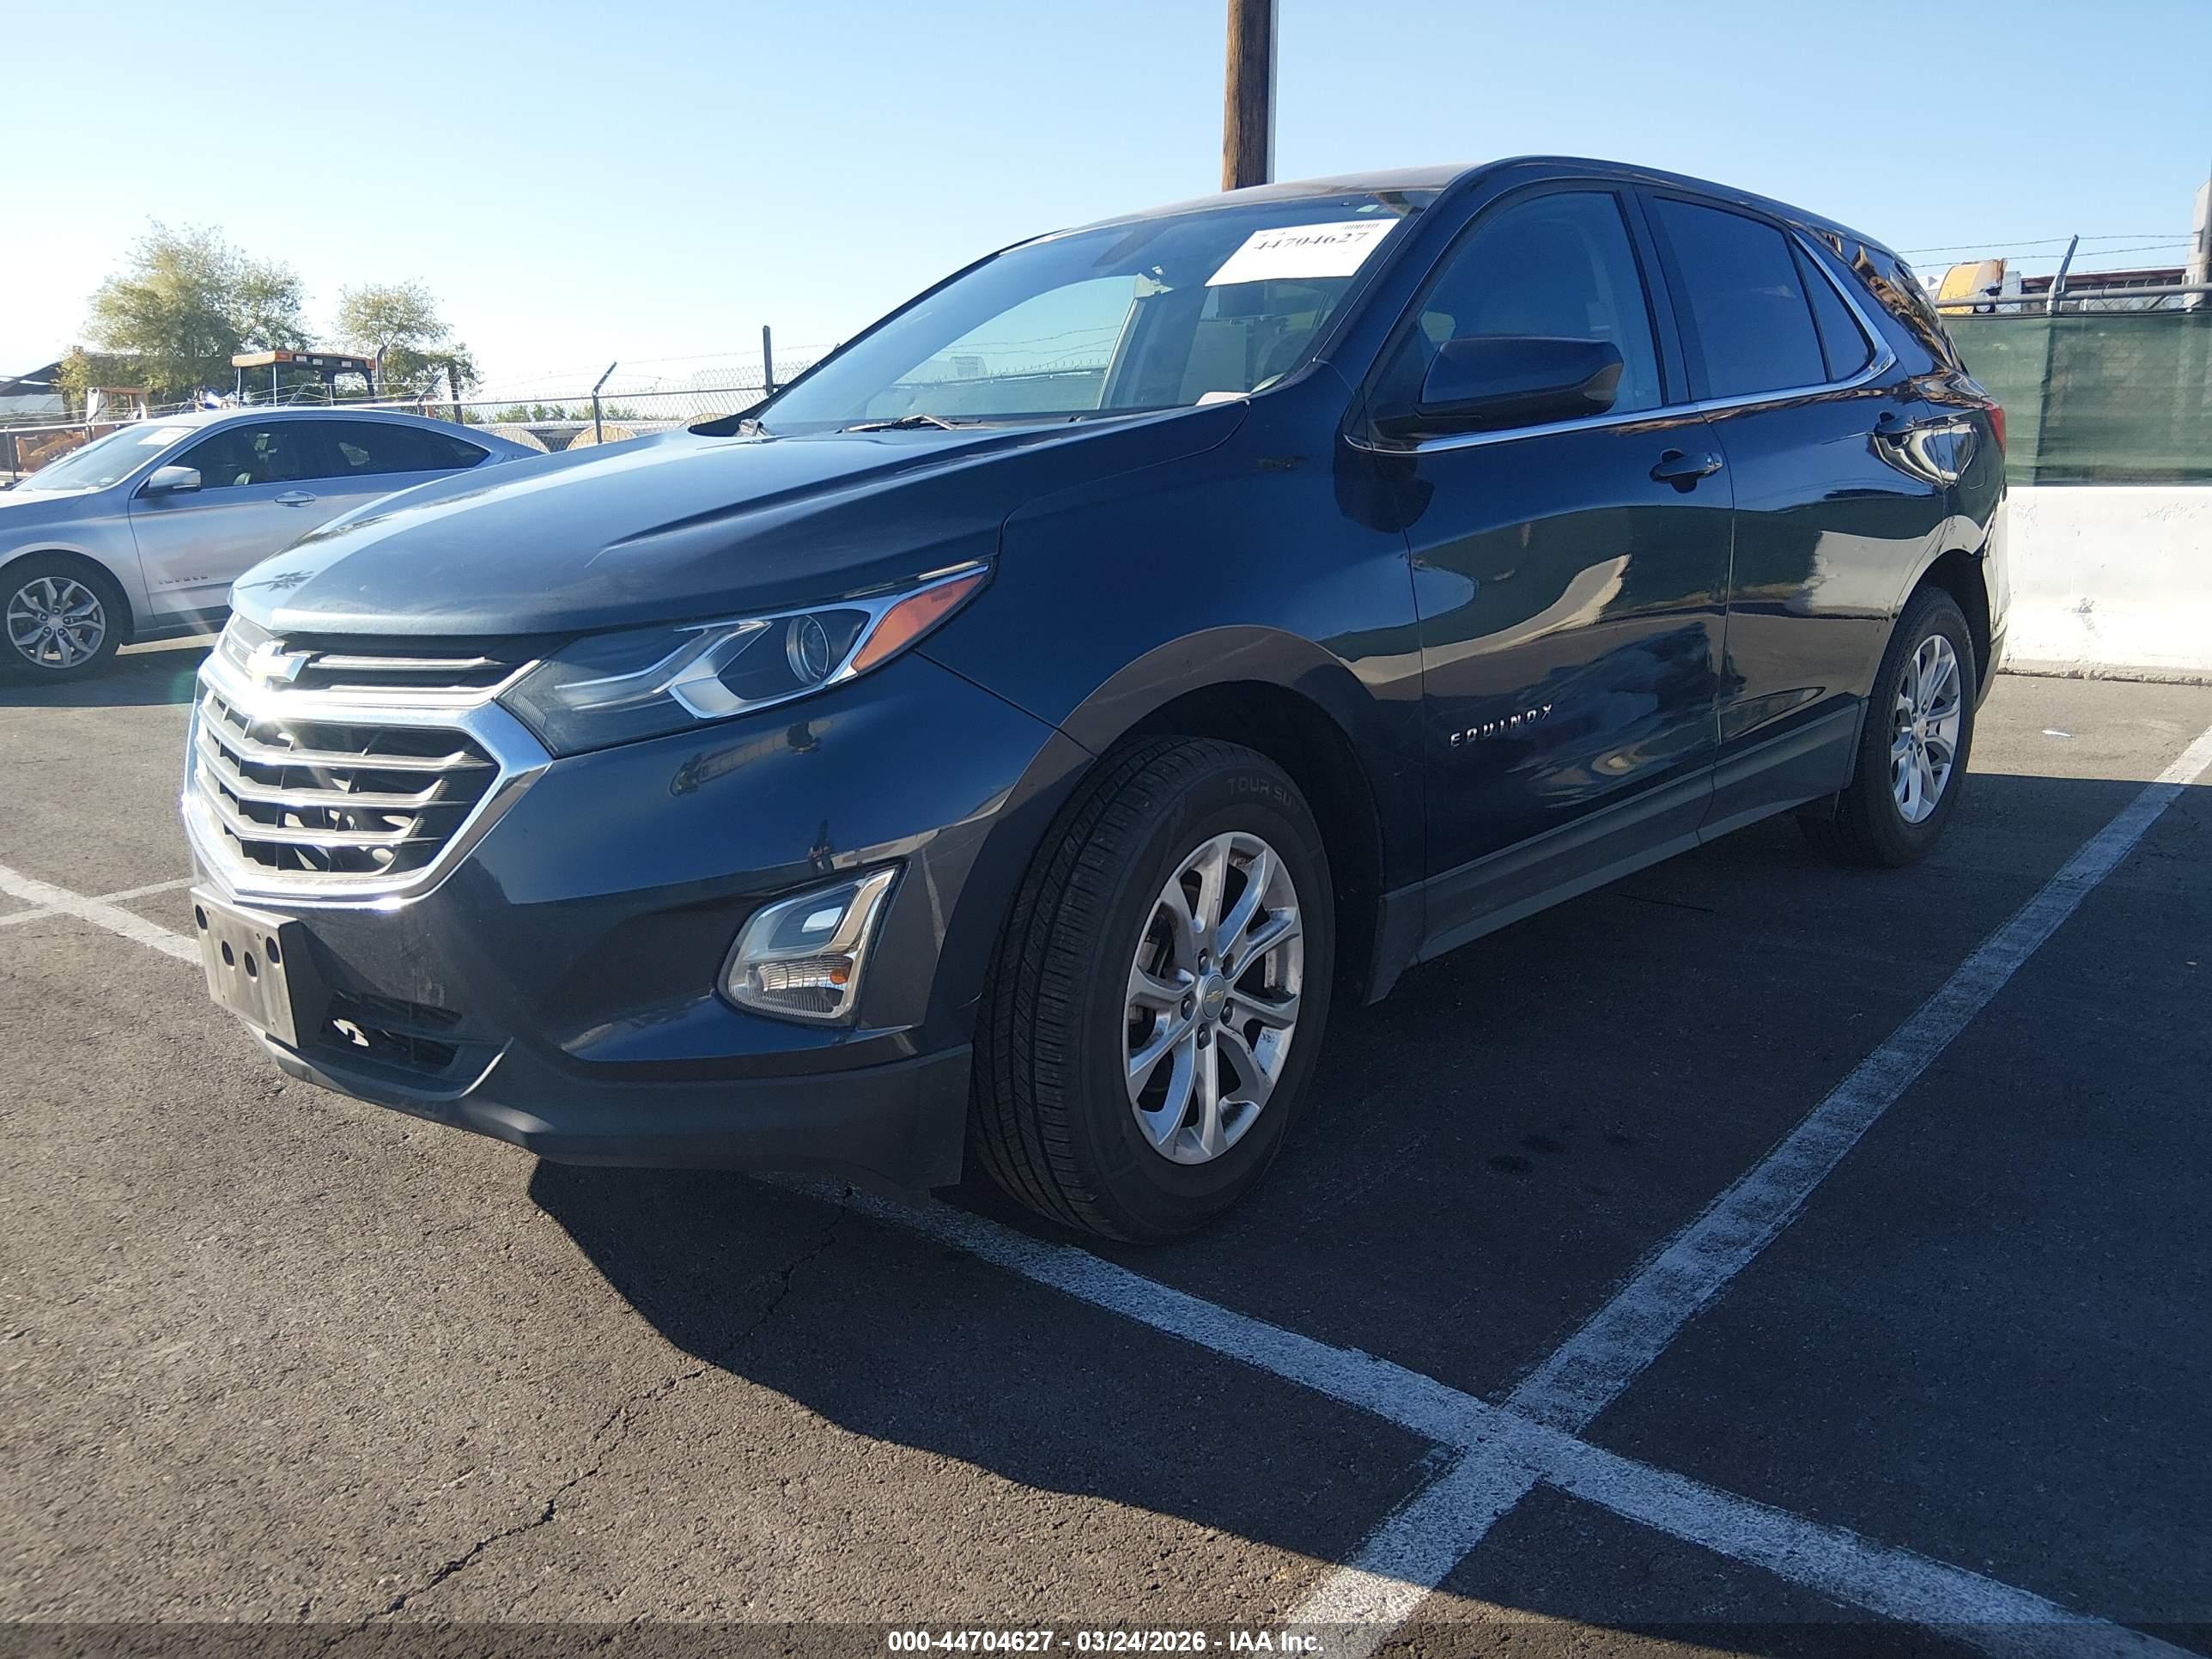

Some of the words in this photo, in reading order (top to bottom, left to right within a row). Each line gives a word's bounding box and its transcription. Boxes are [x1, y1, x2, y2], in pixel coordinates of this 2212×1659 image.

[1254, 232, 1370, 250] 44704627
[1449, 703, 1553, 749] EQUINOX
[1226, 776, 1270, 794] TOUR
